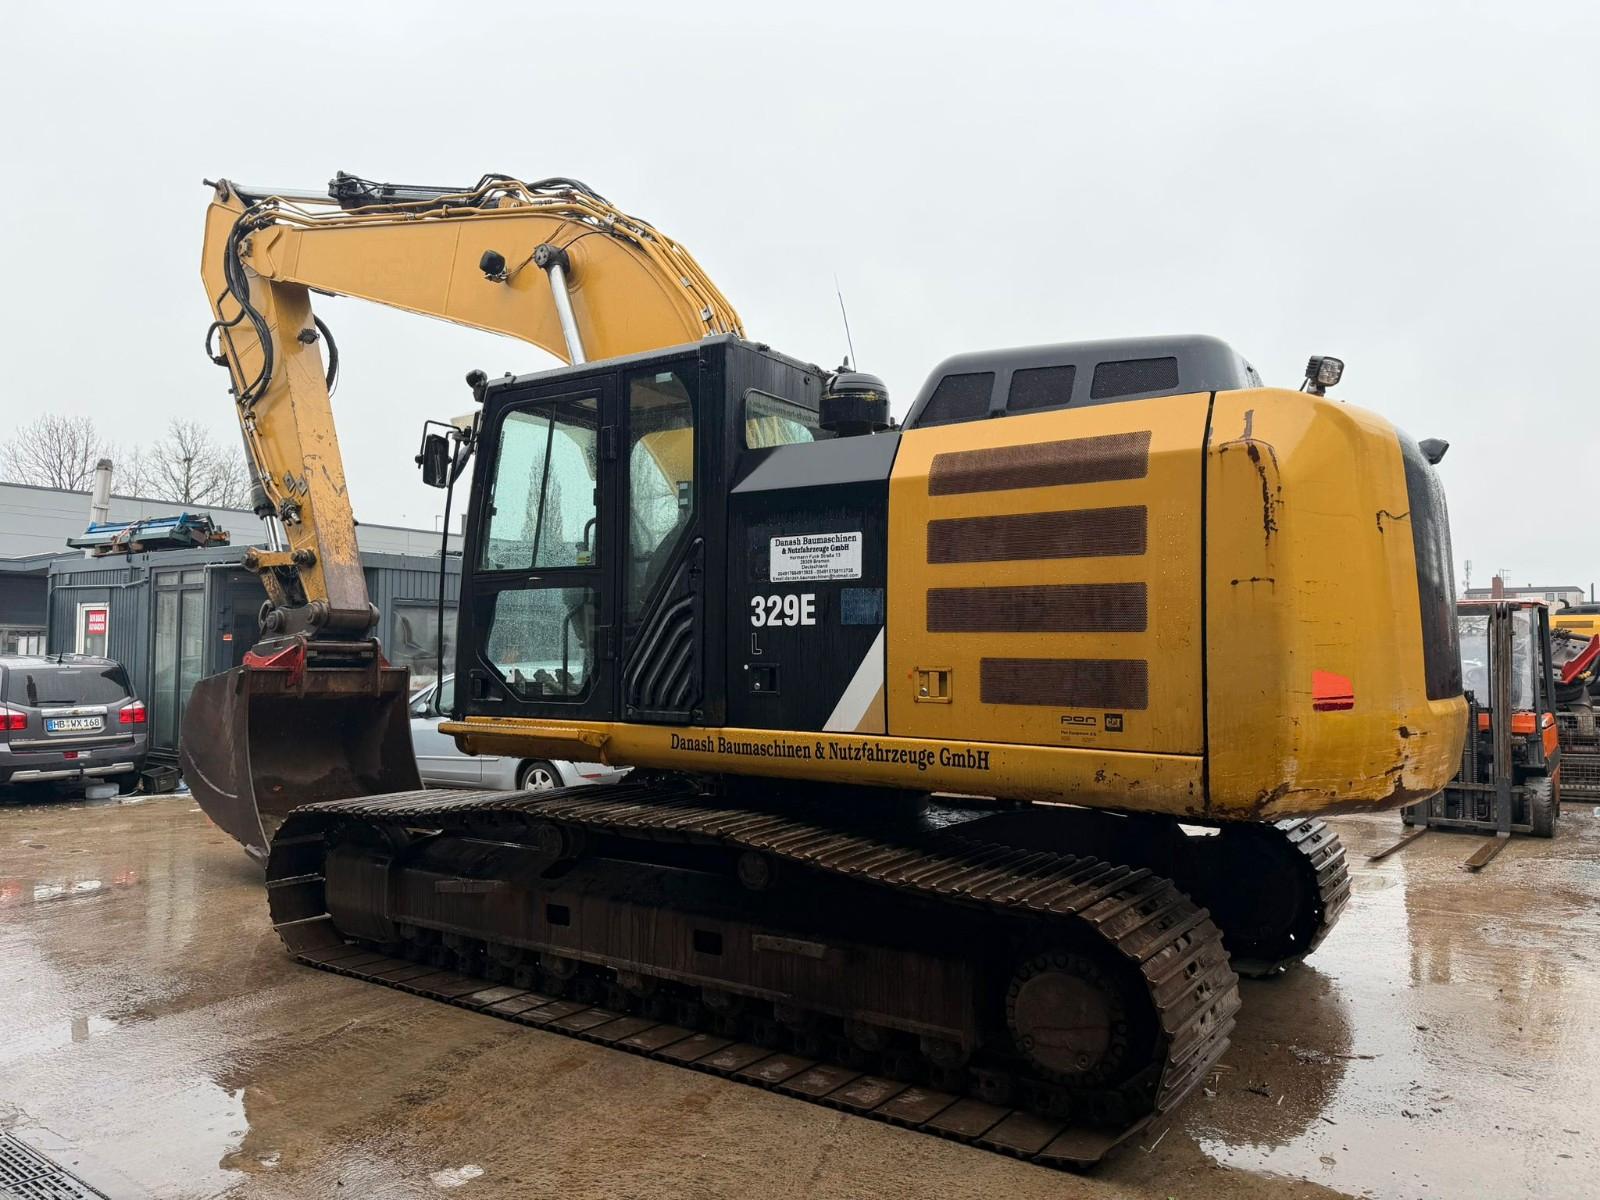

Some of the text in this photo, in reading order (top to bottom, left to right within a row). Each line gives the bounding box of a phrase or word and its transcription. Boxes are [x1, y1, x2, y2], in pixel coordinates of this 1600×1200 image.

[775, 534, 857, 547] Danash Baumaschinen
[787, 546, 830, 555] Nutzfahrzeuge
[830, 544, 849, 552] GmbH
[750, 593, 816, 627] 329E
[53, 718, 100, 729] HB WX 168
[670, 733, 990, 770] Danash Baumaschinen & Nutzfahrzeuge GmbH
